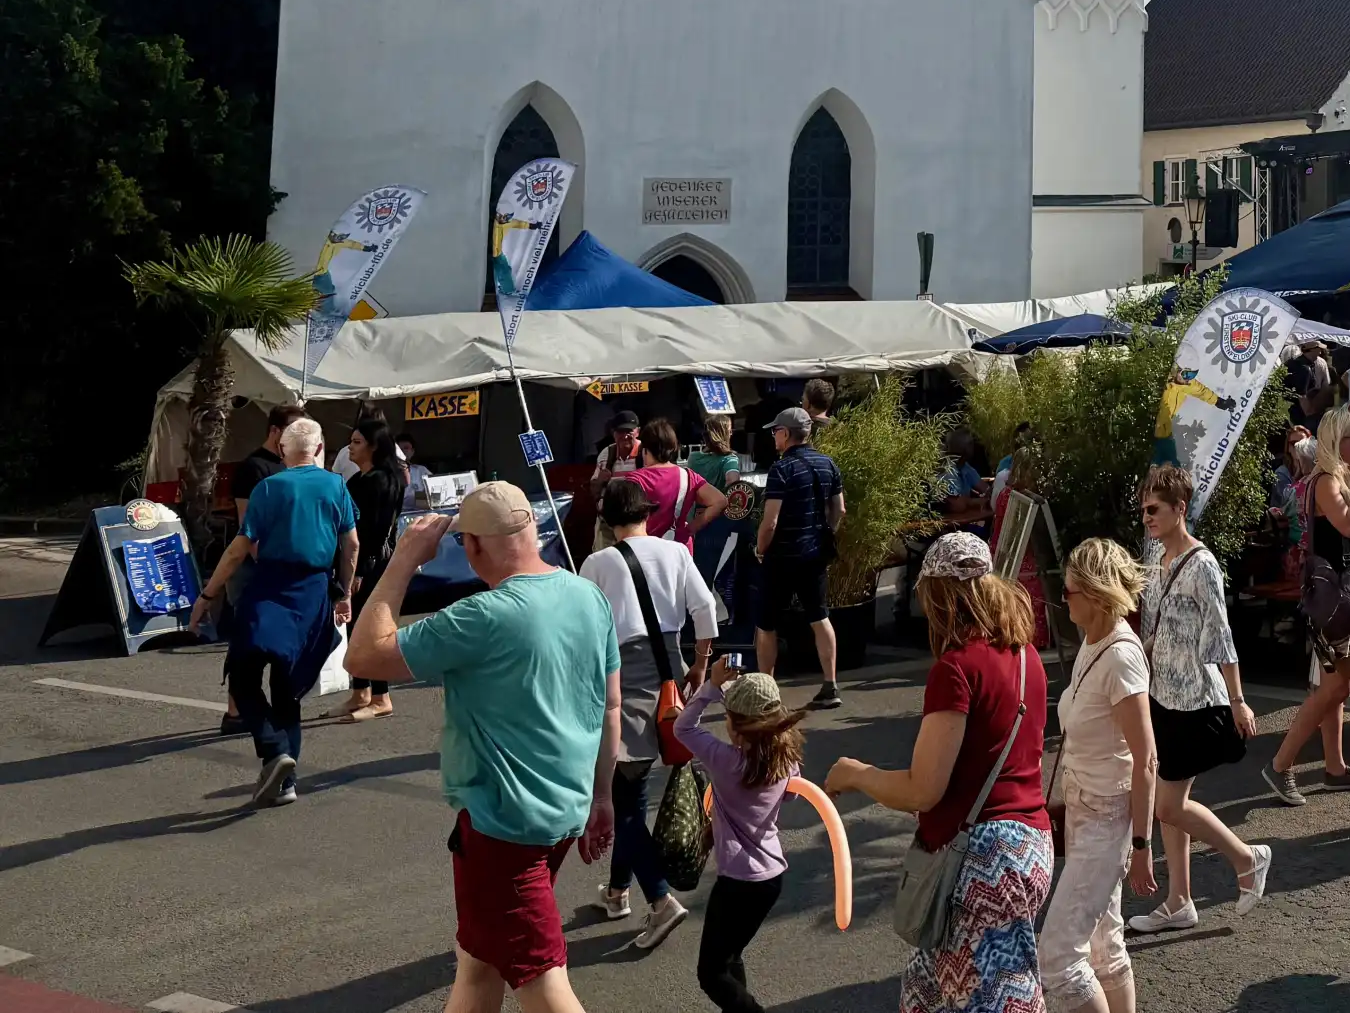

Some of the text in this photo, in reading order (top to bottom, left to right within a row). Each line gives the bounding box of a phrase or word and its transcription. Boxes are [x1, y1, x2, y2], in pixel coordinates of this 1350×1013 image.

[651, 181, 723, 195] GEDENKET
[657, 195, 718, 206] UNSERER
[644, 209, 728, 223] GEFALLENEN
[349, 237, 393, 300] skiclub-ffb.de
[522, 266, 535, 292] noch
[531, 245, 542, 266] viel
[1227, 312, 1258, 323] SKI-CLUB
[600, 382, 644, 394] ZUR KASSE
[411, 394, 470, 418] KASSE
